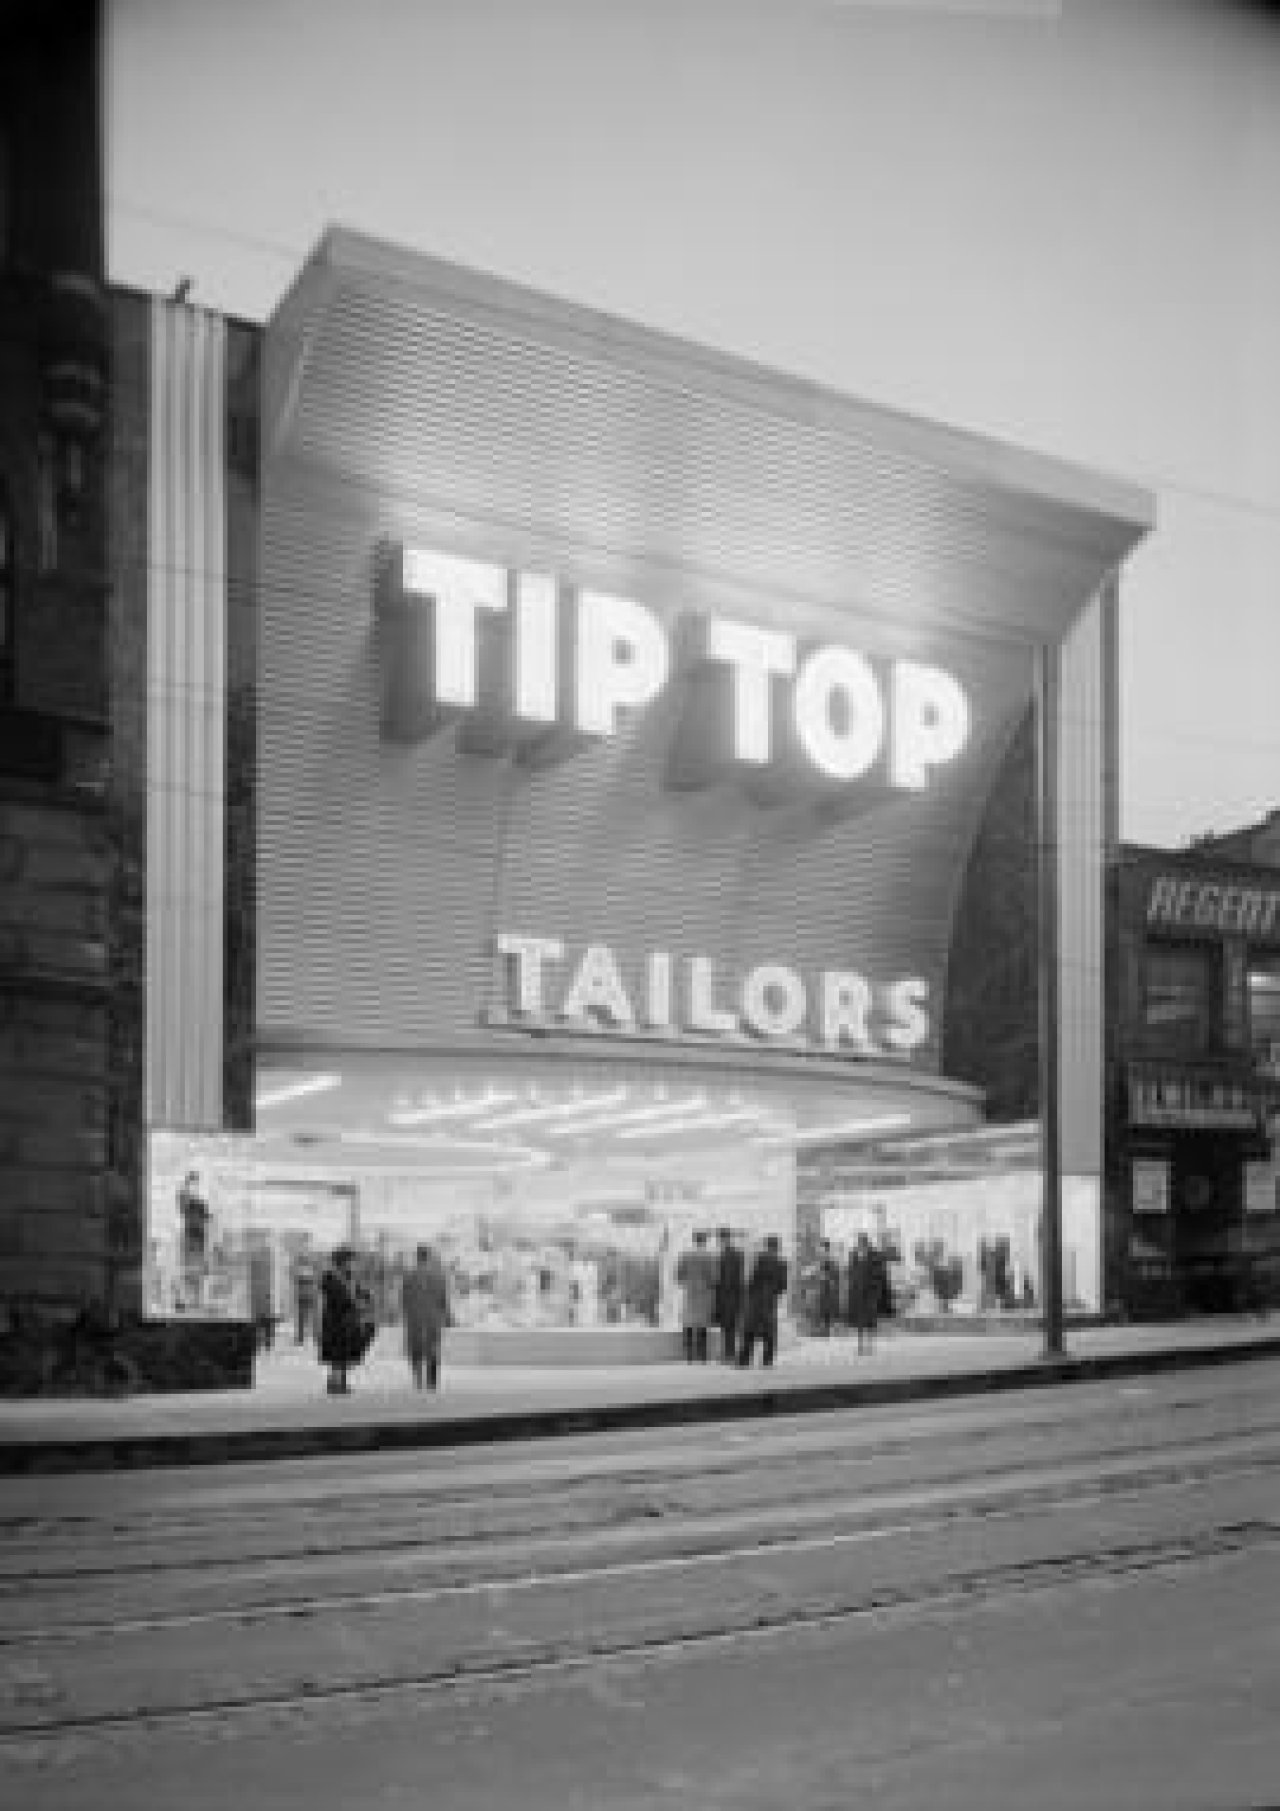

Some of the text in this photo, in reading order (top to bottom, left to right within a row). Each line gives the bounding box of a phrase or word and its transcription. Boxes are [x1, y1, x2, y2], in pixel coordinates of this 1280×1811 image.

[402, 549, 971, 790] TIP TOP
[496, 933, 930, 1052] TAILORS
